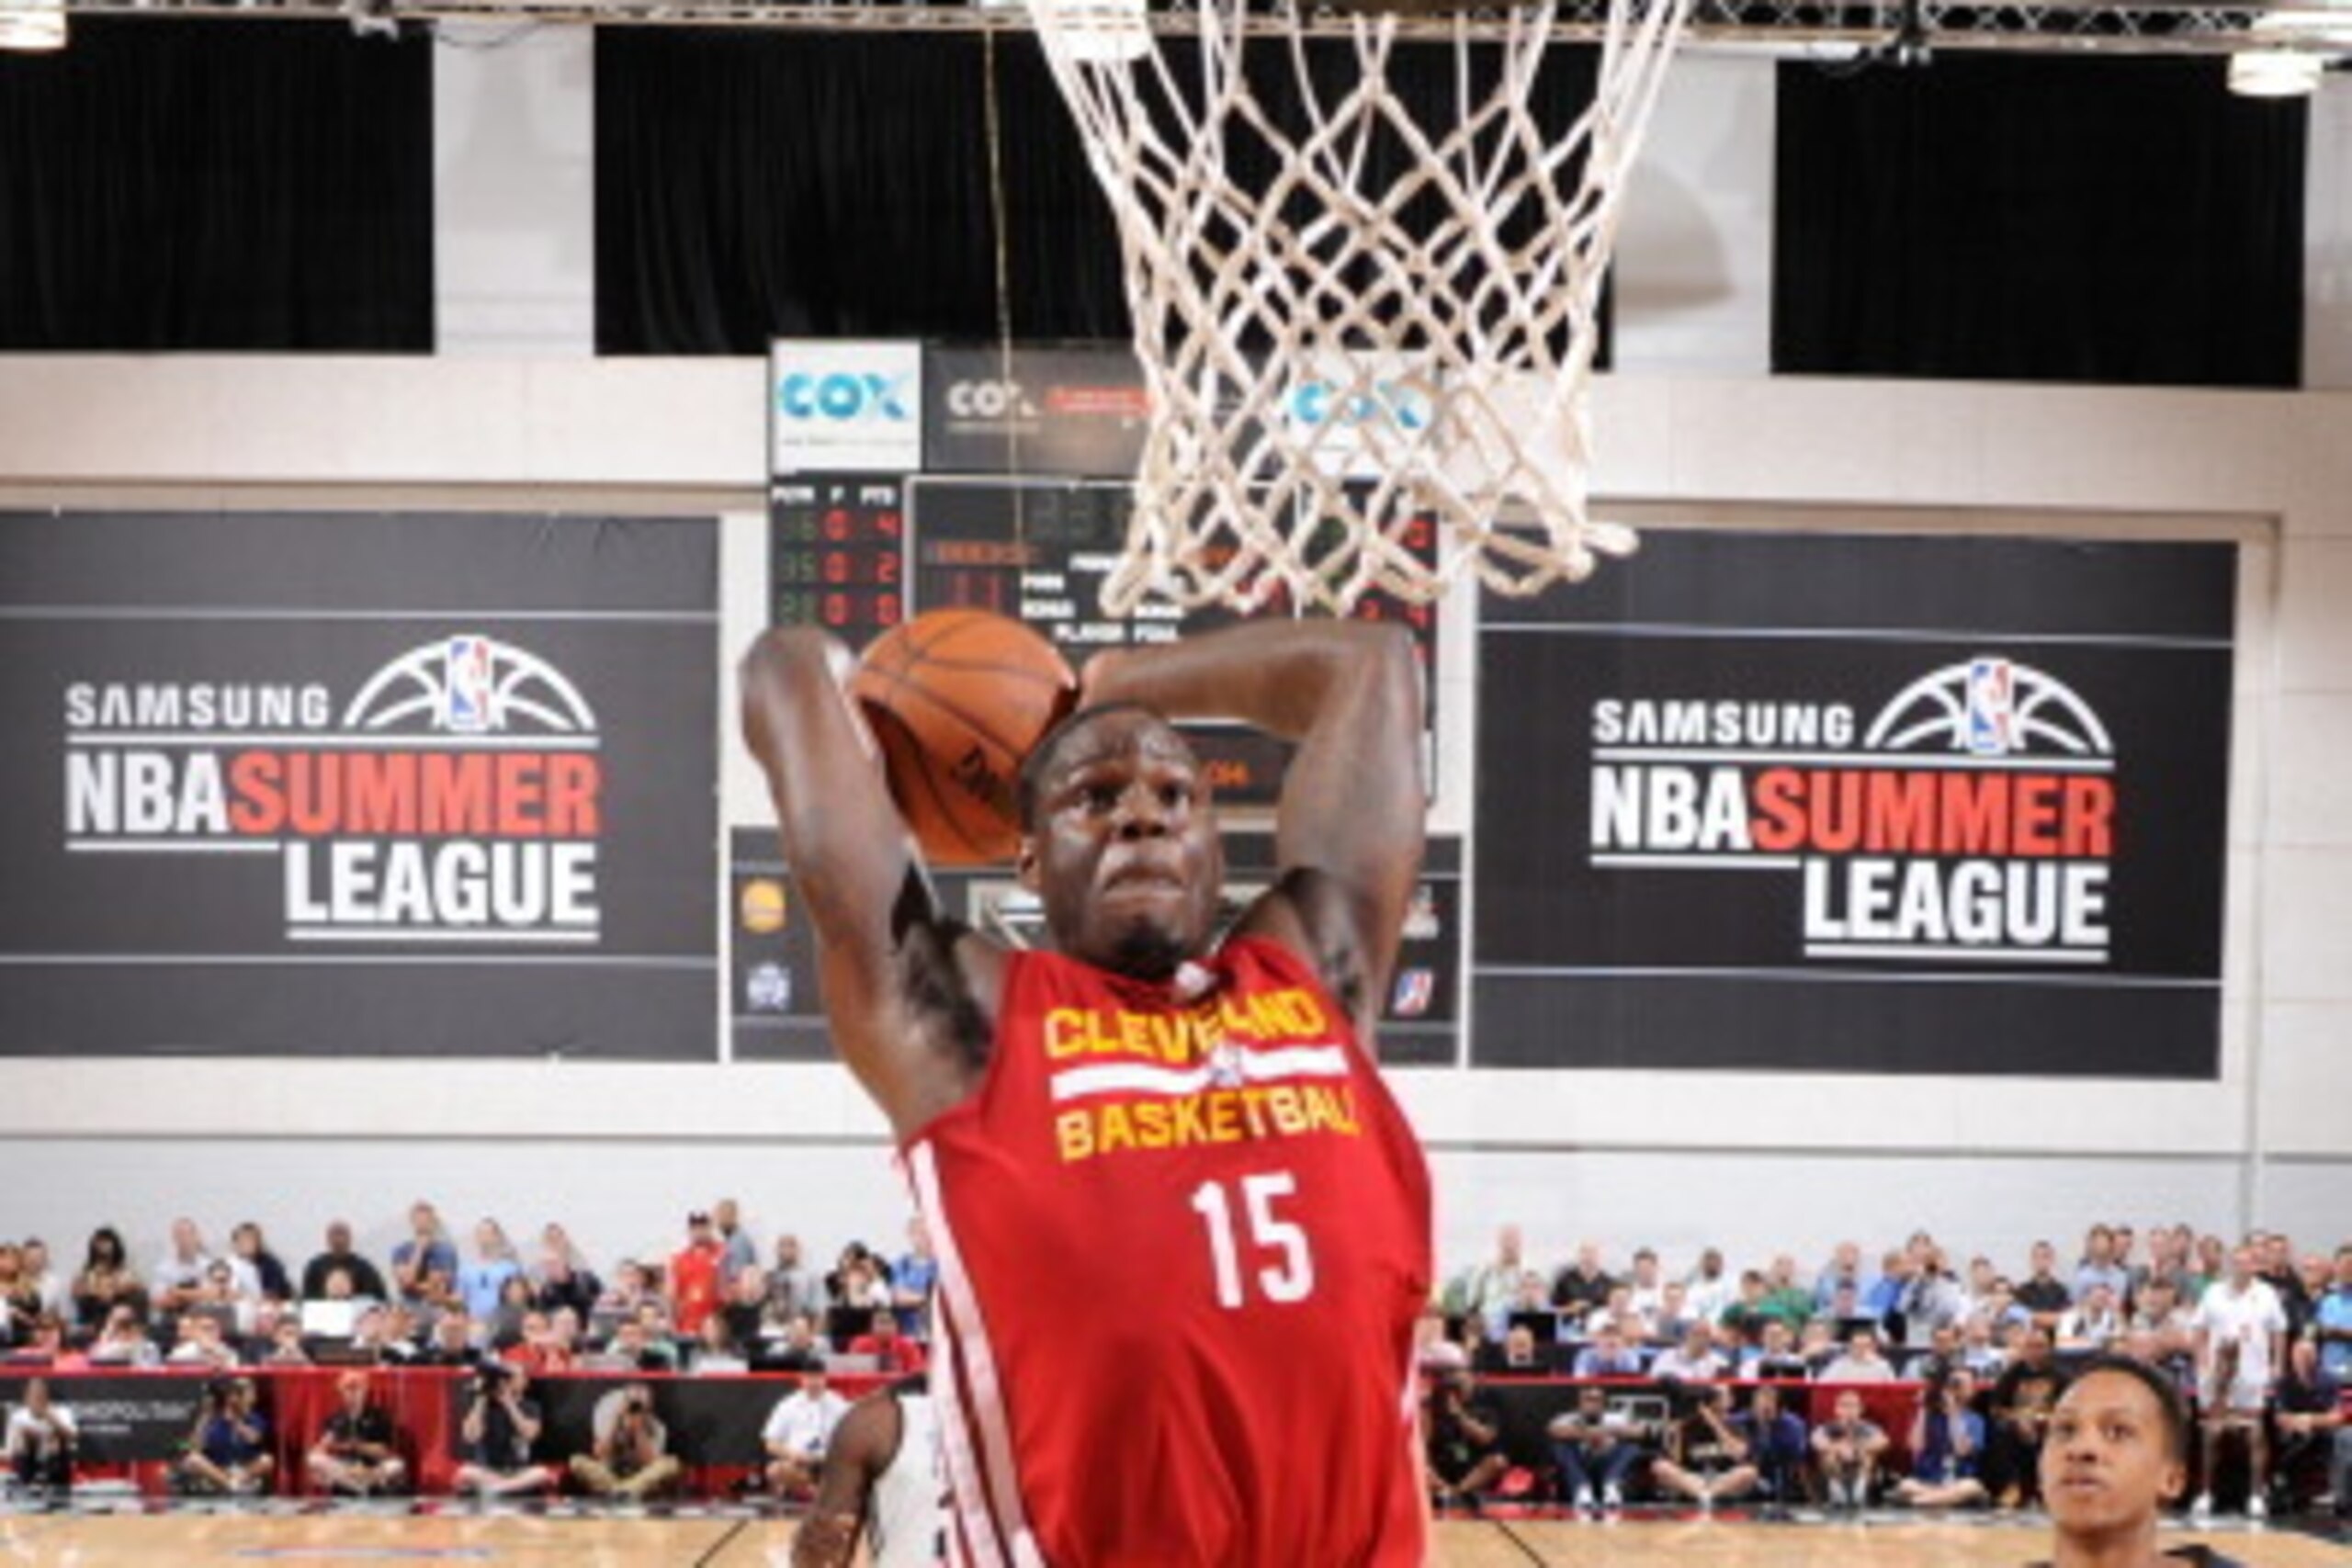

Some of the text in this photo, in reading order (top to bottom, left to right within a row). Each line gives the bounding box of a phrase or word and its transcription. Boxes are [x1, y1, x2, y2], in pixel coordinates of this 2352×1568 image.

[780, 373, 906, 420] COX
[65, 683, 330, 728] SAMSUNG
[1592, 699, 1854, 746] SAMSUNG
[285, 842, 599, 924] LEAGUE
[1804, 860, 2109, 944] LEAGUE
[1192, 1167, 1315, 1308] 15
